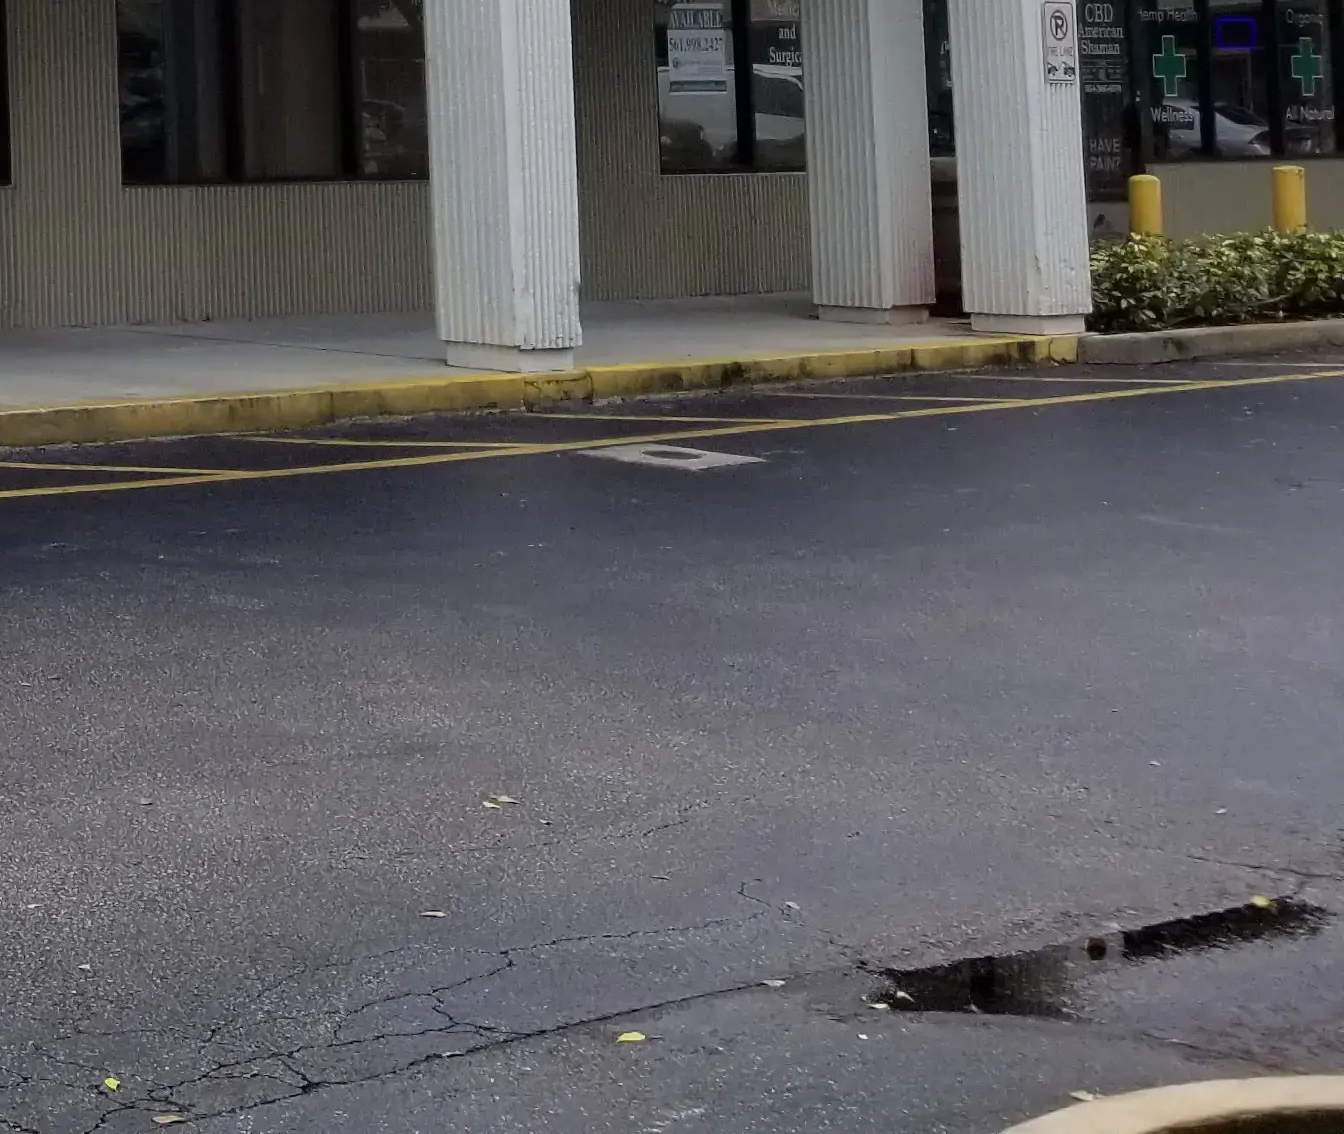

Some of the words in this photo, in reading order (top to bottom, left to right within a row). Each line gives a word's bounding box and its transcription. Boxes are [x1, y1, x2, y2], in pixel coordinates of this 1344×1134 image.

[669, 9, 723, 28] AVAILABLE
[1085, 3, 1114, 23] CBD
[778, 23, 797, 40] and
[1078, 23, 1123, 38] American
[1081, 39, 1120, 55] Shaman
[1150, 106, 1194, 123] Wellness
[1300, 105, 1335, 122] Natural
[1089, 138, 1121, 153] HAVE
